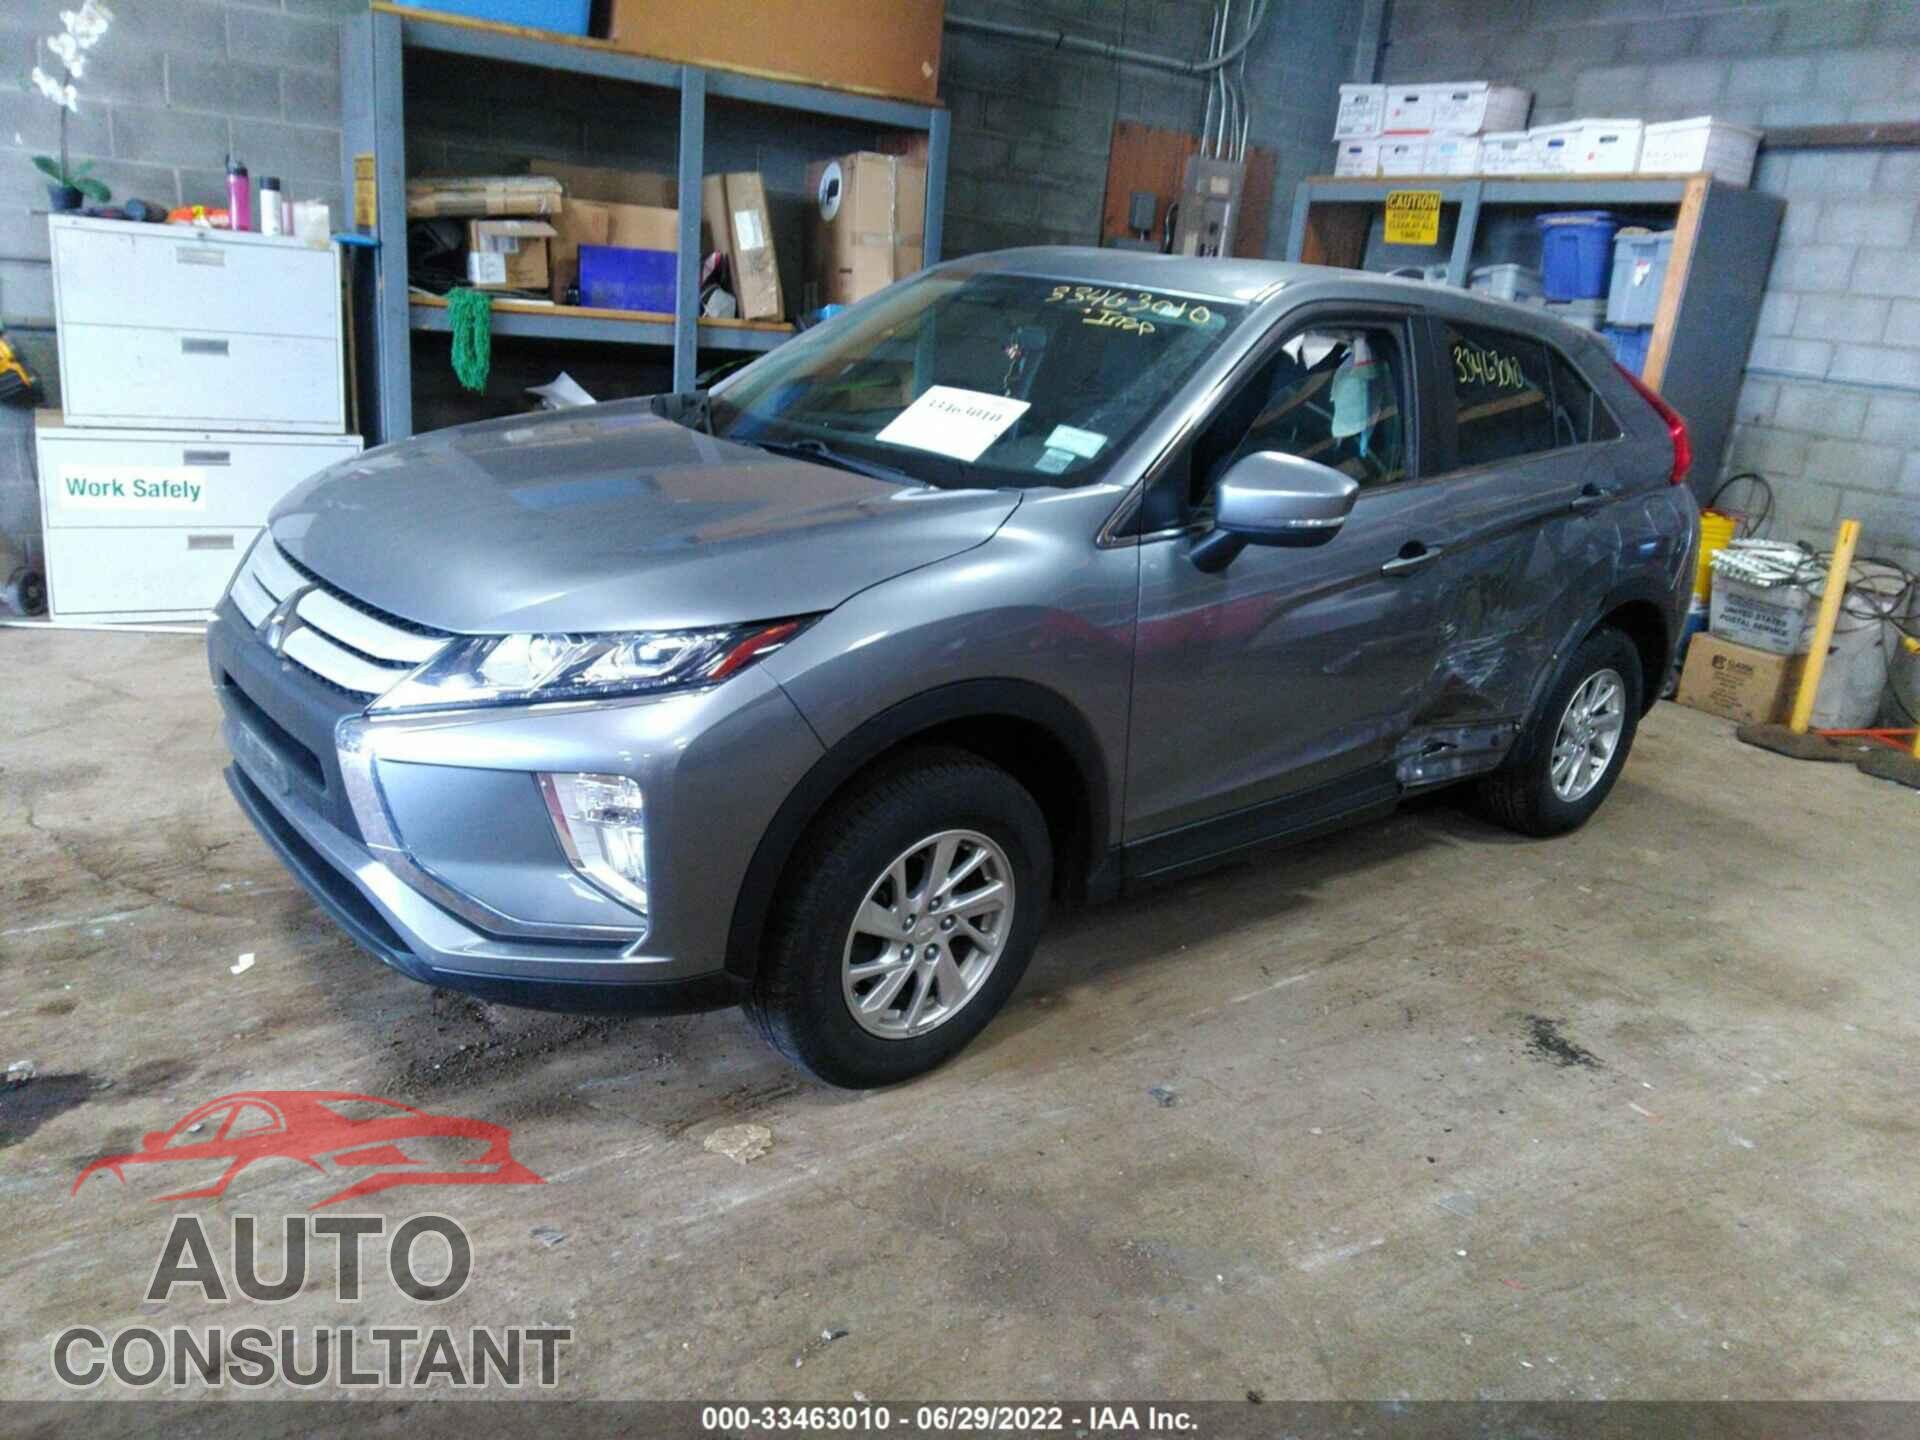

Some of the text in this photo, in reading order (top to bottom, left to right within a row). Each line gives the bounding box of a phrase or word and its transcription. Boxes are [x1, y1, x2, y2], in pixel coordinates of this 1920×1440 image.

[1387, 192, 1438, 210] CAUTION
[65, 476, 201, 503] Work Safely
[1720, 613, 1788, 637] POSTAL SERVICE
[1724, 605, 1787, 627] UNITED STATES
